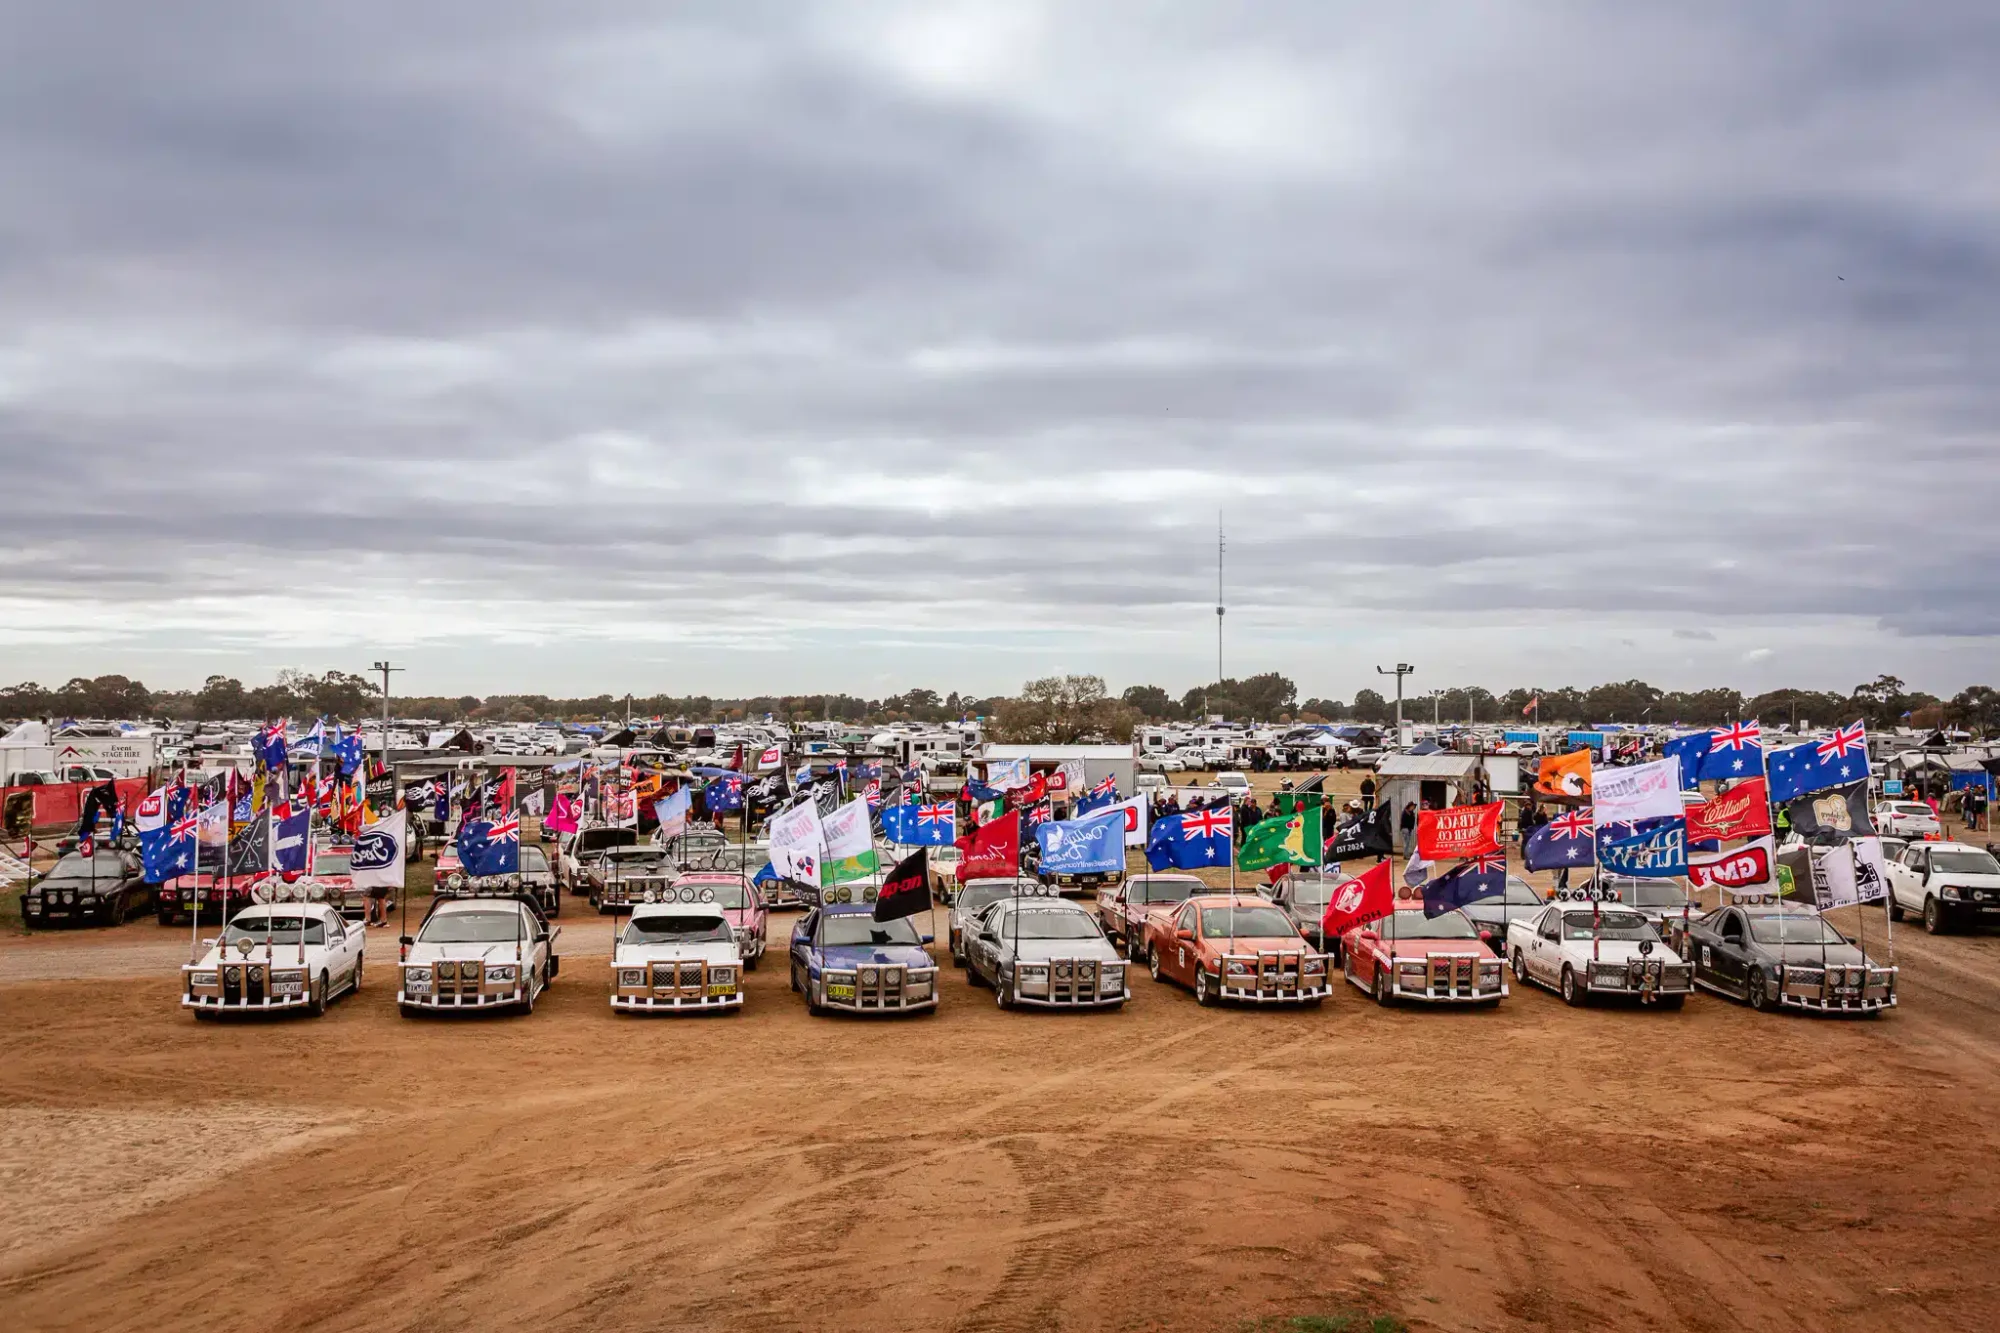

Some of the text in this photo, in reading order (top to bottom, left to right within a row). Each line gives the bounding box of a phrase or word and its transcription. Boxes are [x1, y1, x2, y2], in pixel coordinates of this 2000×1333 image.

[1703, 794, 1751, 824] Williams
[1336, 842, 1365, 854] EST 2024
